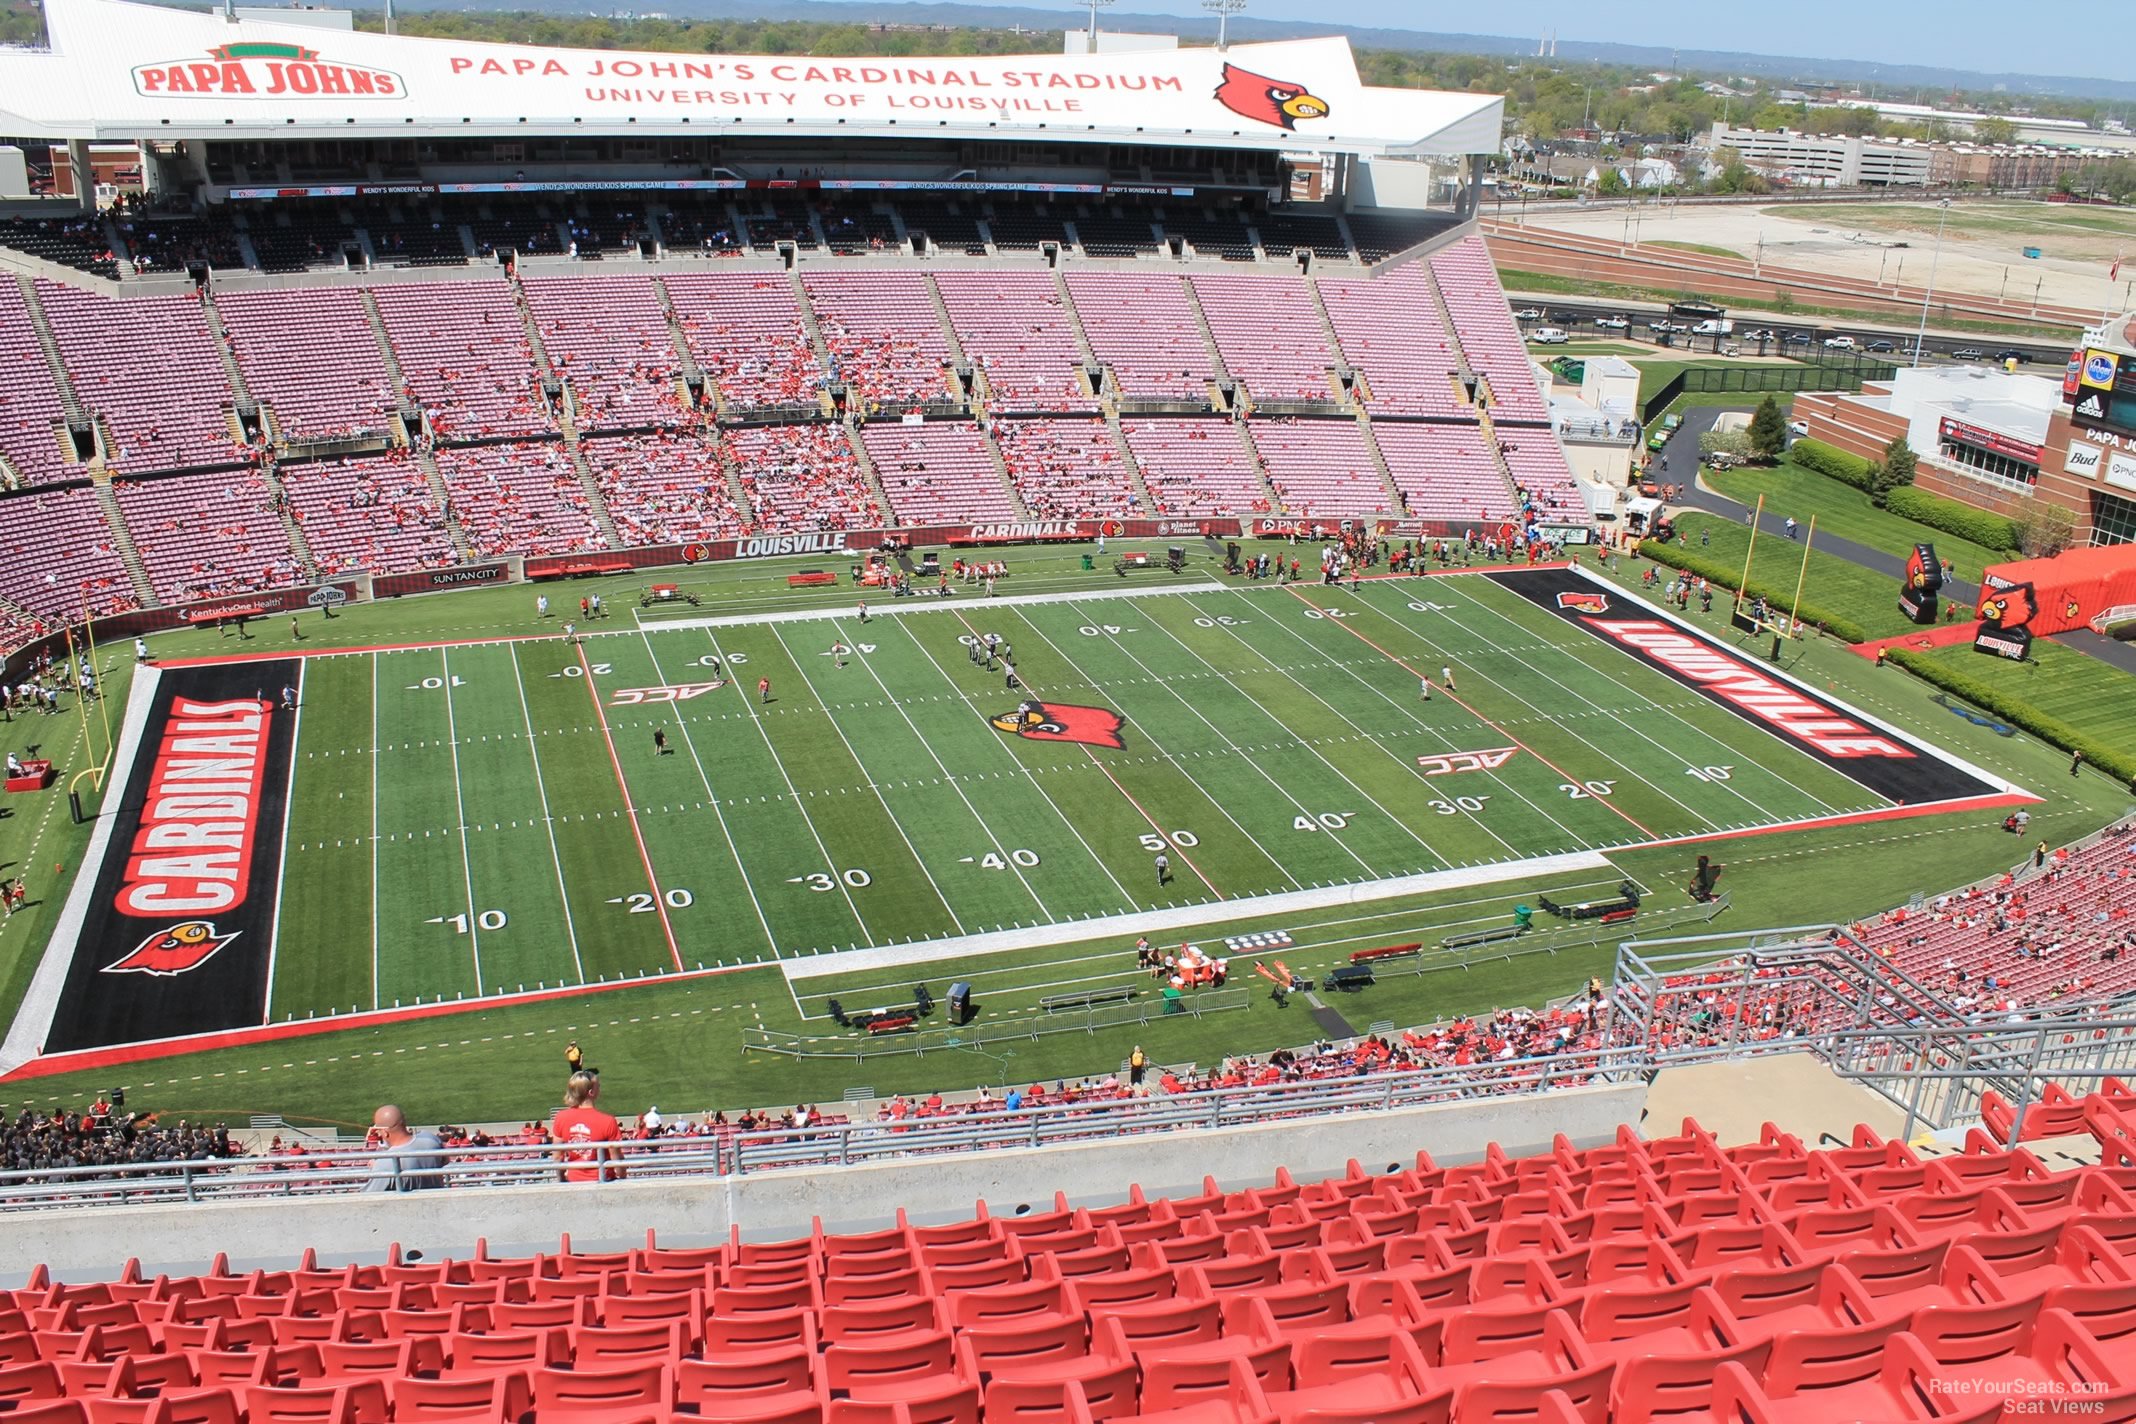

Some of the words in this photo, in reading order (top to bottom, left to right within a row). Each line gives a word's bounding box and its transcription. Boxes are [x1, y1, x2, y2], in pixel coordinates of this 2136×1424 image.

[140, 62, 257, 93] PAPA
[449, 57, 569, 76] PAPA
[586, 60, 755, 81] JOHN'S
[770, 66, 992, 87] CARDINAL
[1003, 71, 1183, 92] STADIUM
[584, 88, 797, 106] UNIVERSITY
[824, 94, 866, 107] OF
[887, 95, 1083, 112] LOUISVILLE
[387, 185, 420, 193] WONDERFUL
[421, 185, 435, 193] KIDS
[620, 182, 644, 190] SPRING
[2076, 405, 2104, 418] adidas
[2086, 428, 2120, 448] PAPA
[2070, 452, 2099, 466] Bud
[970, 521, 1078, 538] CARDINALS
[1171, 521, 1196, 530] planet
[1396, 521, 1424, 529] Marriott
[735, 533, 847, 558] LOUISVILLE
[433, 573, 453, 584] SUN
[455, 571, 476, 582] TAN
[476, 568, 498, 578] CITY
[191, 603, 252, 618] KentuckyOne
[1303, 607, 1350, 620] 20
[1406, 600, 1446, 612] 10
[1078, 623, 1122, 637] 40
[1191, 615, 1239, 628] 30
[1976, 634, 2024, 655] LOUISVILLE
[562, 662, 613, 678] 20
[421, 674, 467, 690] 10
[1589, 618, 1909, 757] LOUISVILLE
[1684, 765, 1733, 783] 10
[1558, 780, 1614, 800] 20
[125, 699, 267, 914] CARDINALS
[1427, 796, 1484, 816] 30
[1292, 812, 1349, 833] 40
[1138, 829, 1200, 852] 50
[980, 847, 1041, 871] 40
[803, 867, 873, 893] 30
[626, 888, 694, 915] 20
[446, 908, 509, 934] 10
